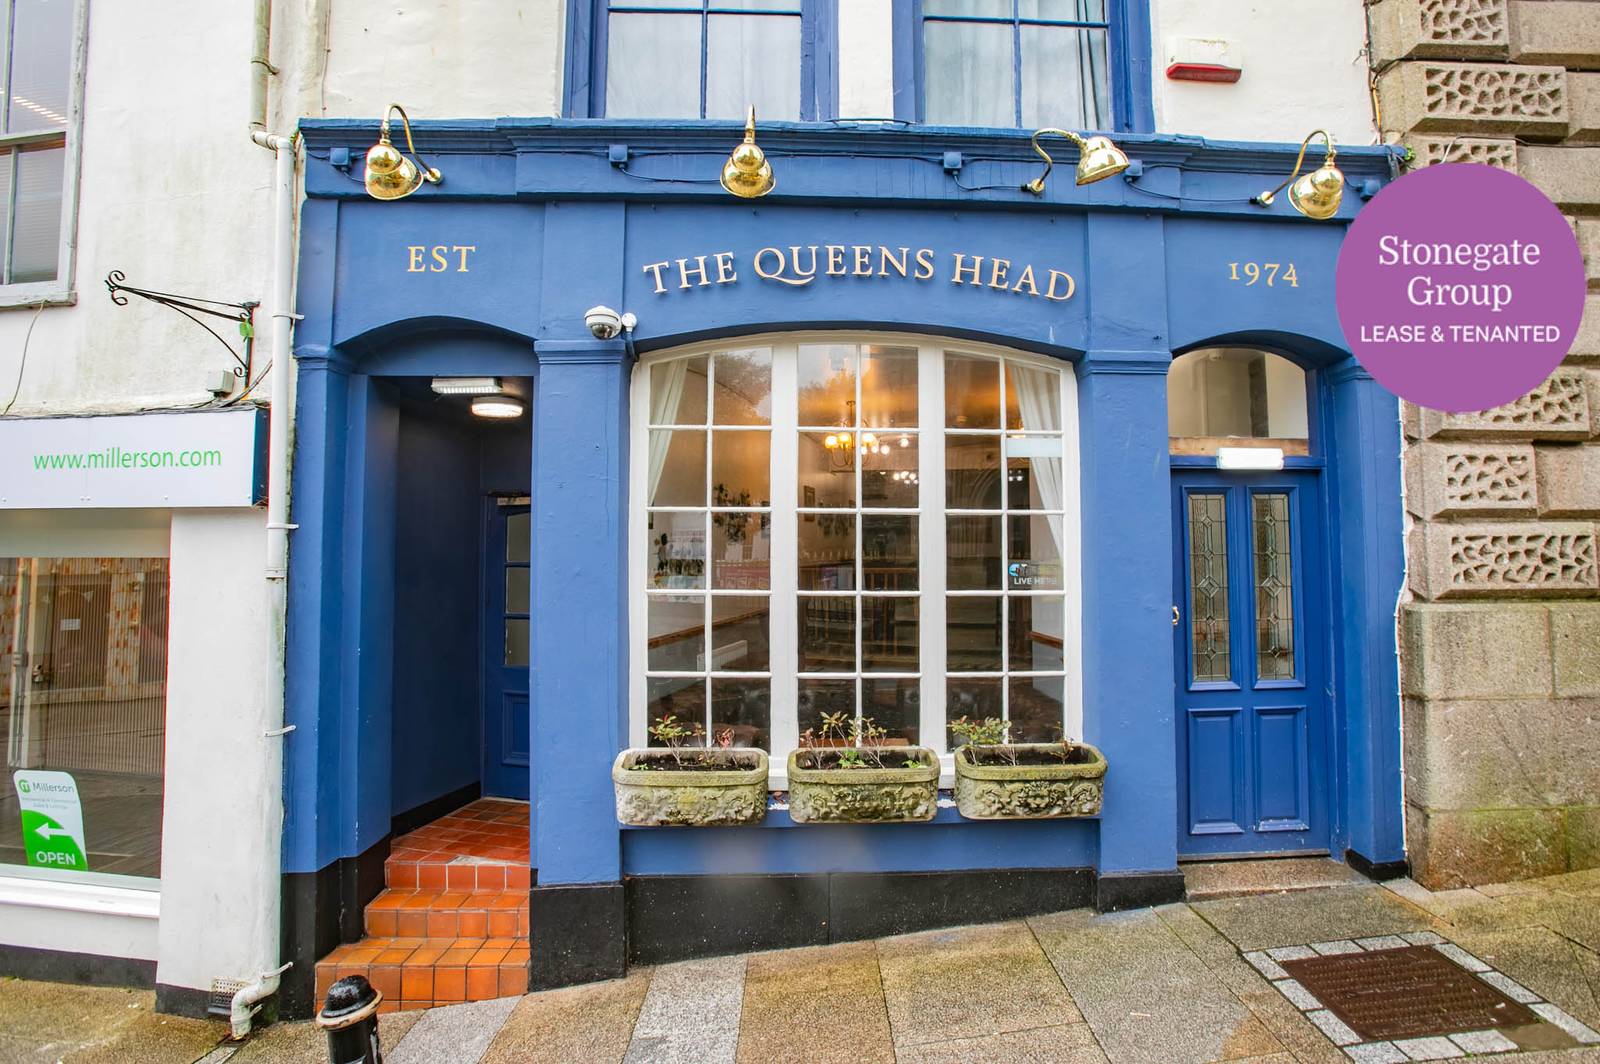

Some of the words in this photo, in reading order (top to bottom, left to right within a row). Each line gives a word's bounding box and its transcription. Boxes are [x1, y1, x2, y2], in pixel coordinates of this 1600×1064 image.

[407, 245, 476, 273] EST
[643, 251, 738, 294] THE
[753, 245, 934, 285] QUEENS
[951, 253, 1076, 301] HEAD
[1228, 262, 1299, 288] 1974
[33, 447, 222, 470] www.millerson.com
[1013, 577, 1032, 585] LIVE
[32, 782, 75, 793] Millerson
[36, 851, 76, 865] OPEN
